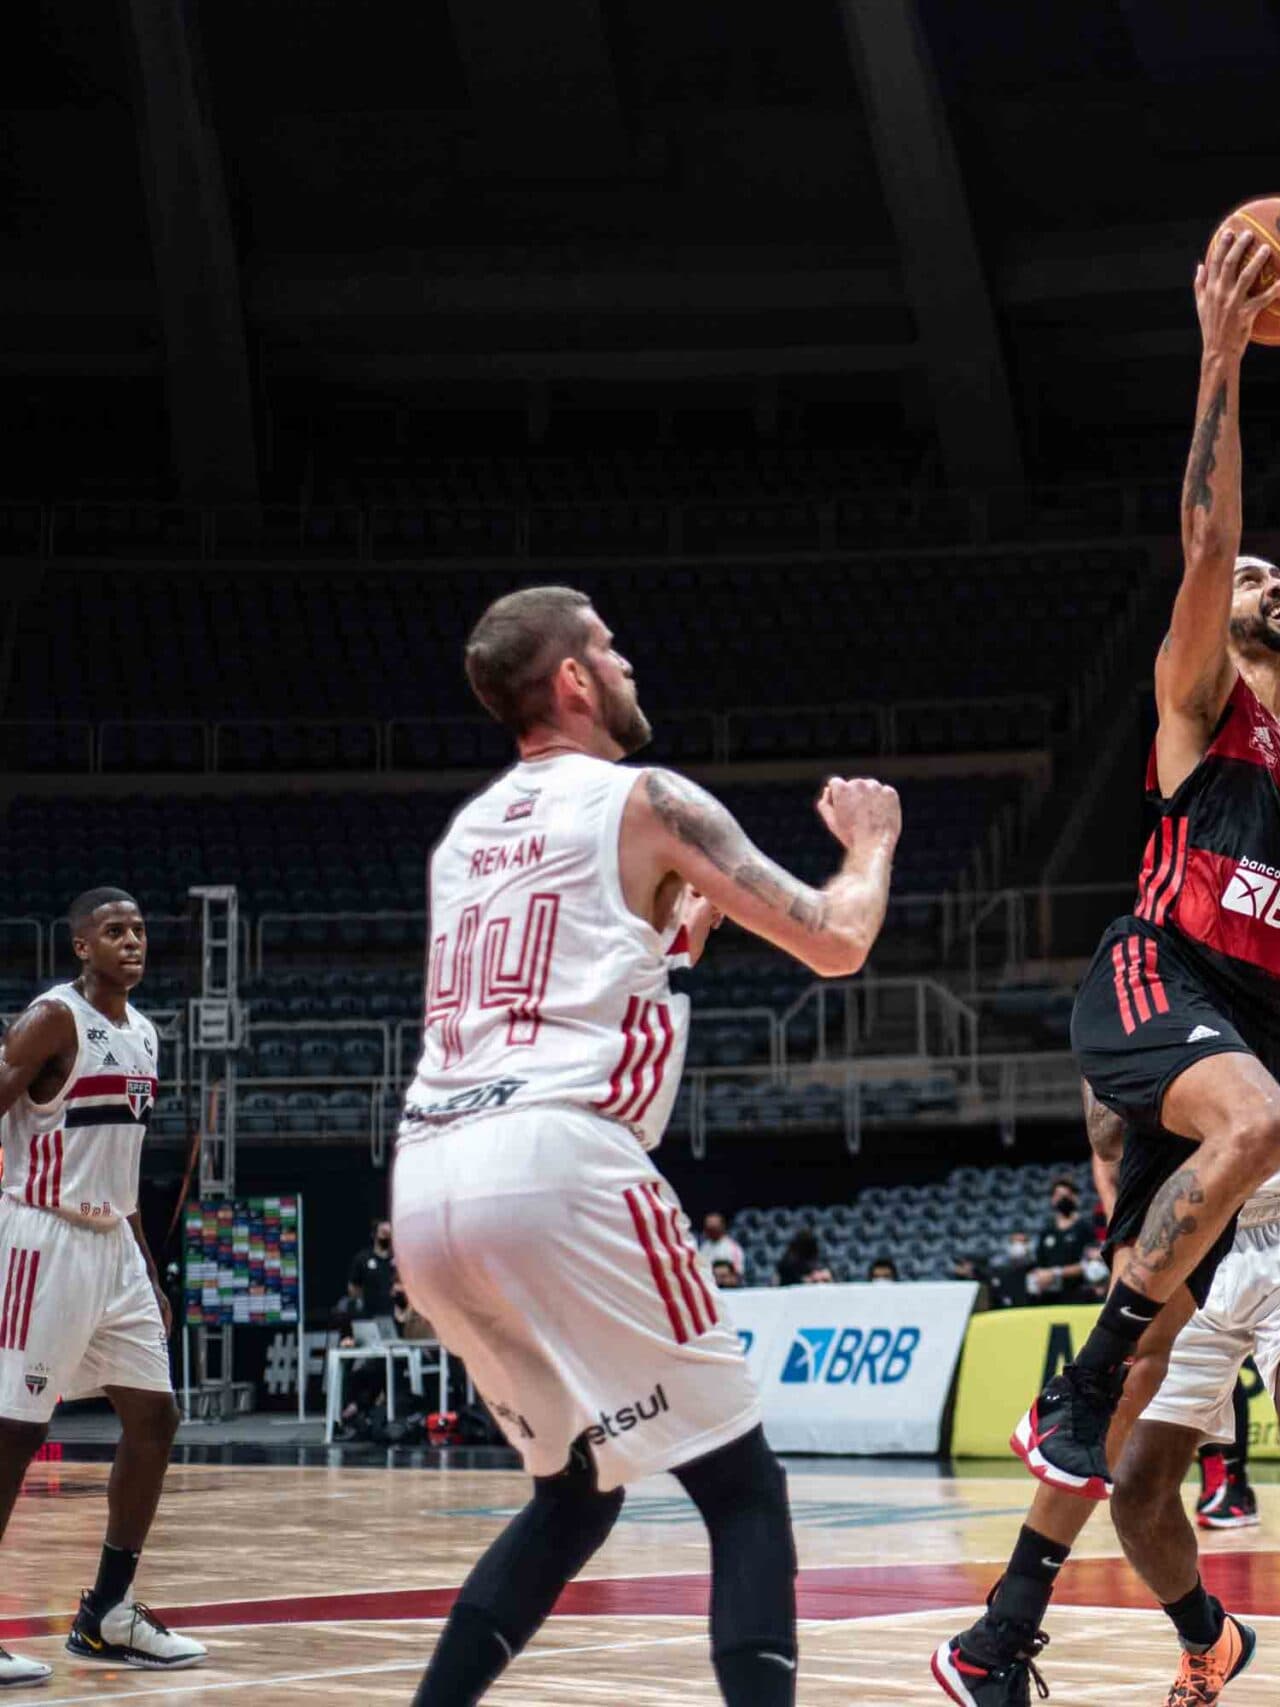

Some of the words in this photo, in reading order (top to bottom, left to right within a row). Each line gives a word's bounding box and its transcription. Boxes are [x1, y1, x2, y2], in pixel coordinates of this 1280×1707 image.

[469, 834, 546, 879] RENAN
[426, 891, 561, 1070] 44
[826, 1326, 921, 1384] BRB
[586, 1383, 669, 1445] etsul
